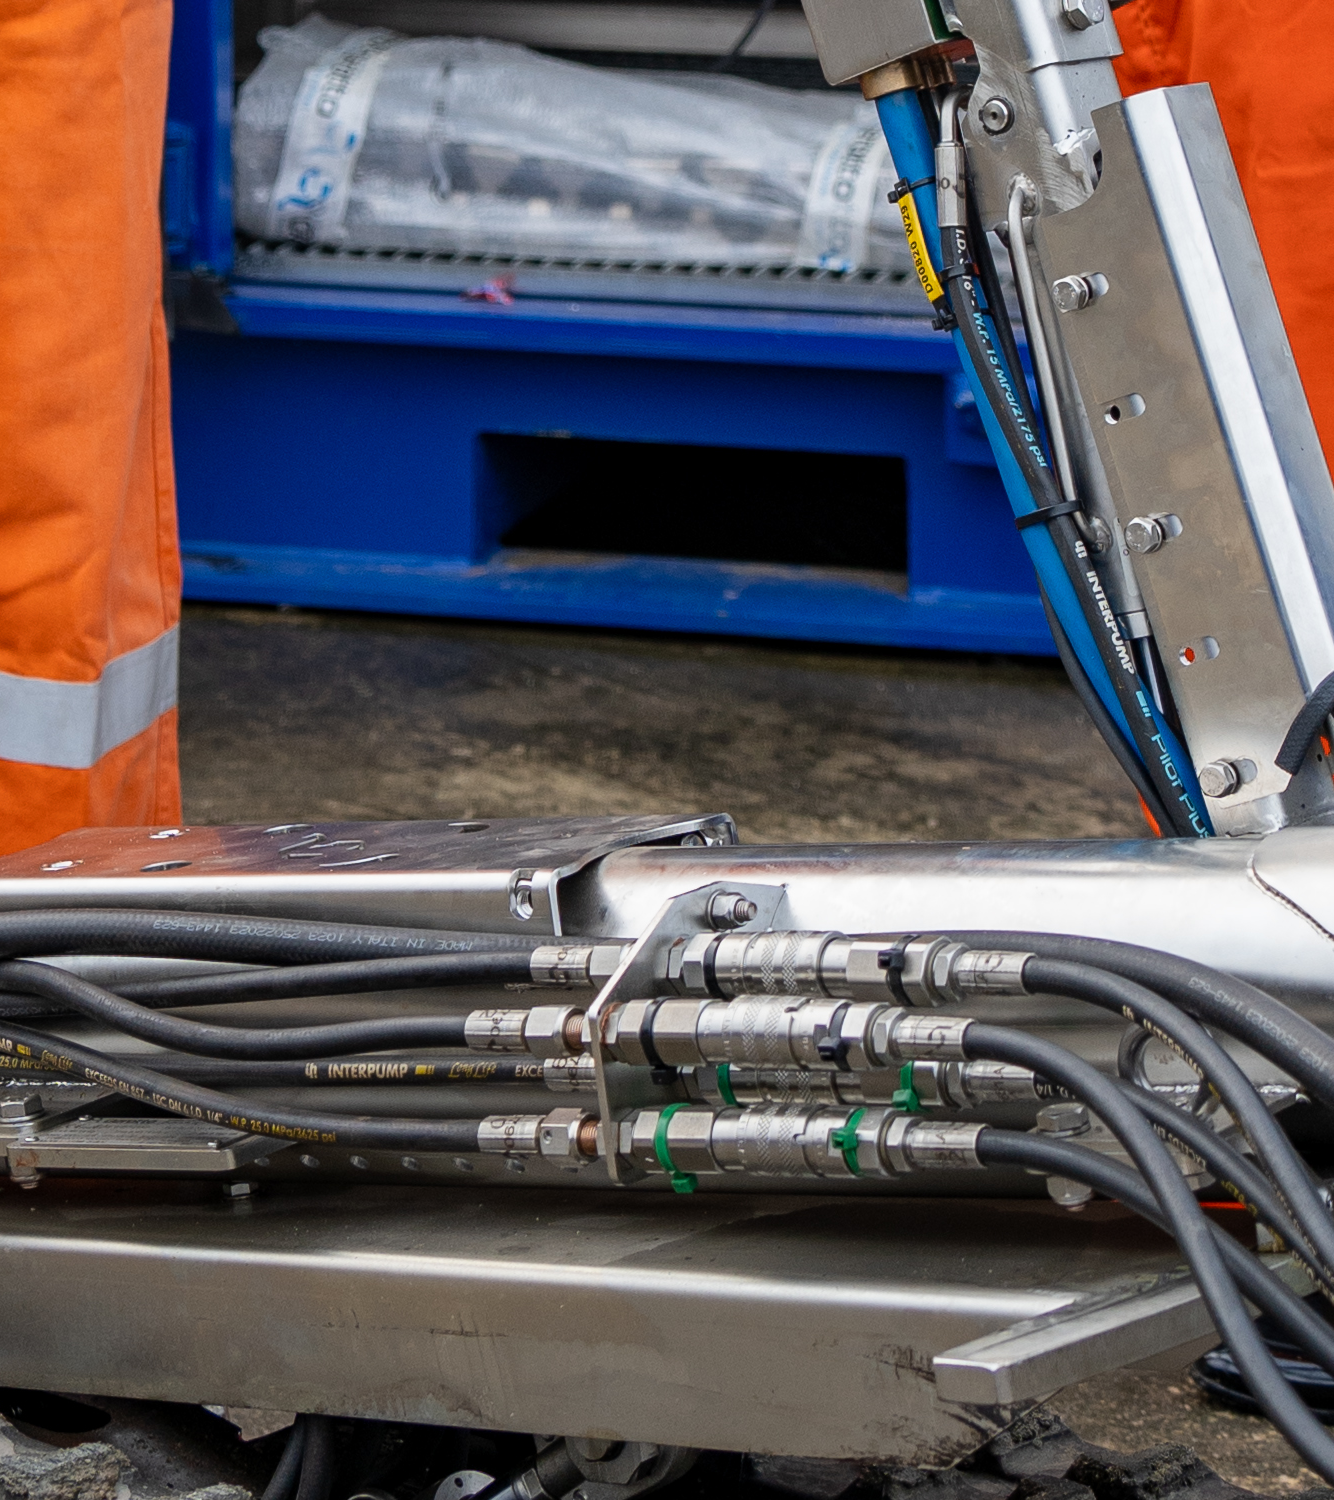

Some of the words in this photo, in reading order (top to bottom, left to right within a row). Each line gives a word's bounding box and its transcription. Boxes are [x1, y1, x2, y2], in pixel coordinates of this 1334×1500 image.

[899, 204, 913, 236] W29
[908, 240, 933, 293] D00820
[955, 229, 966, 253] I.D.
[970, 310, 993, 344] W.P.
[985, 347, 1000, 365] 15
[993, 366, 1035, 444] MPa/2175
[1085, 569, 1135, 676] INTERPUMP
[153, 918, 219, 934] 1443-623
[229, 924, 302, 939] 25022023
[308, 928, 346, 943] 1023
[352, 932, 397, 947] ITALY
[405, 936, 425, 949] IN
[434, 938, 472, 952] MADE
[328, 1063, 408, 1078] INTERPUMP
[515, 1064, 543, 1077] EXCE
